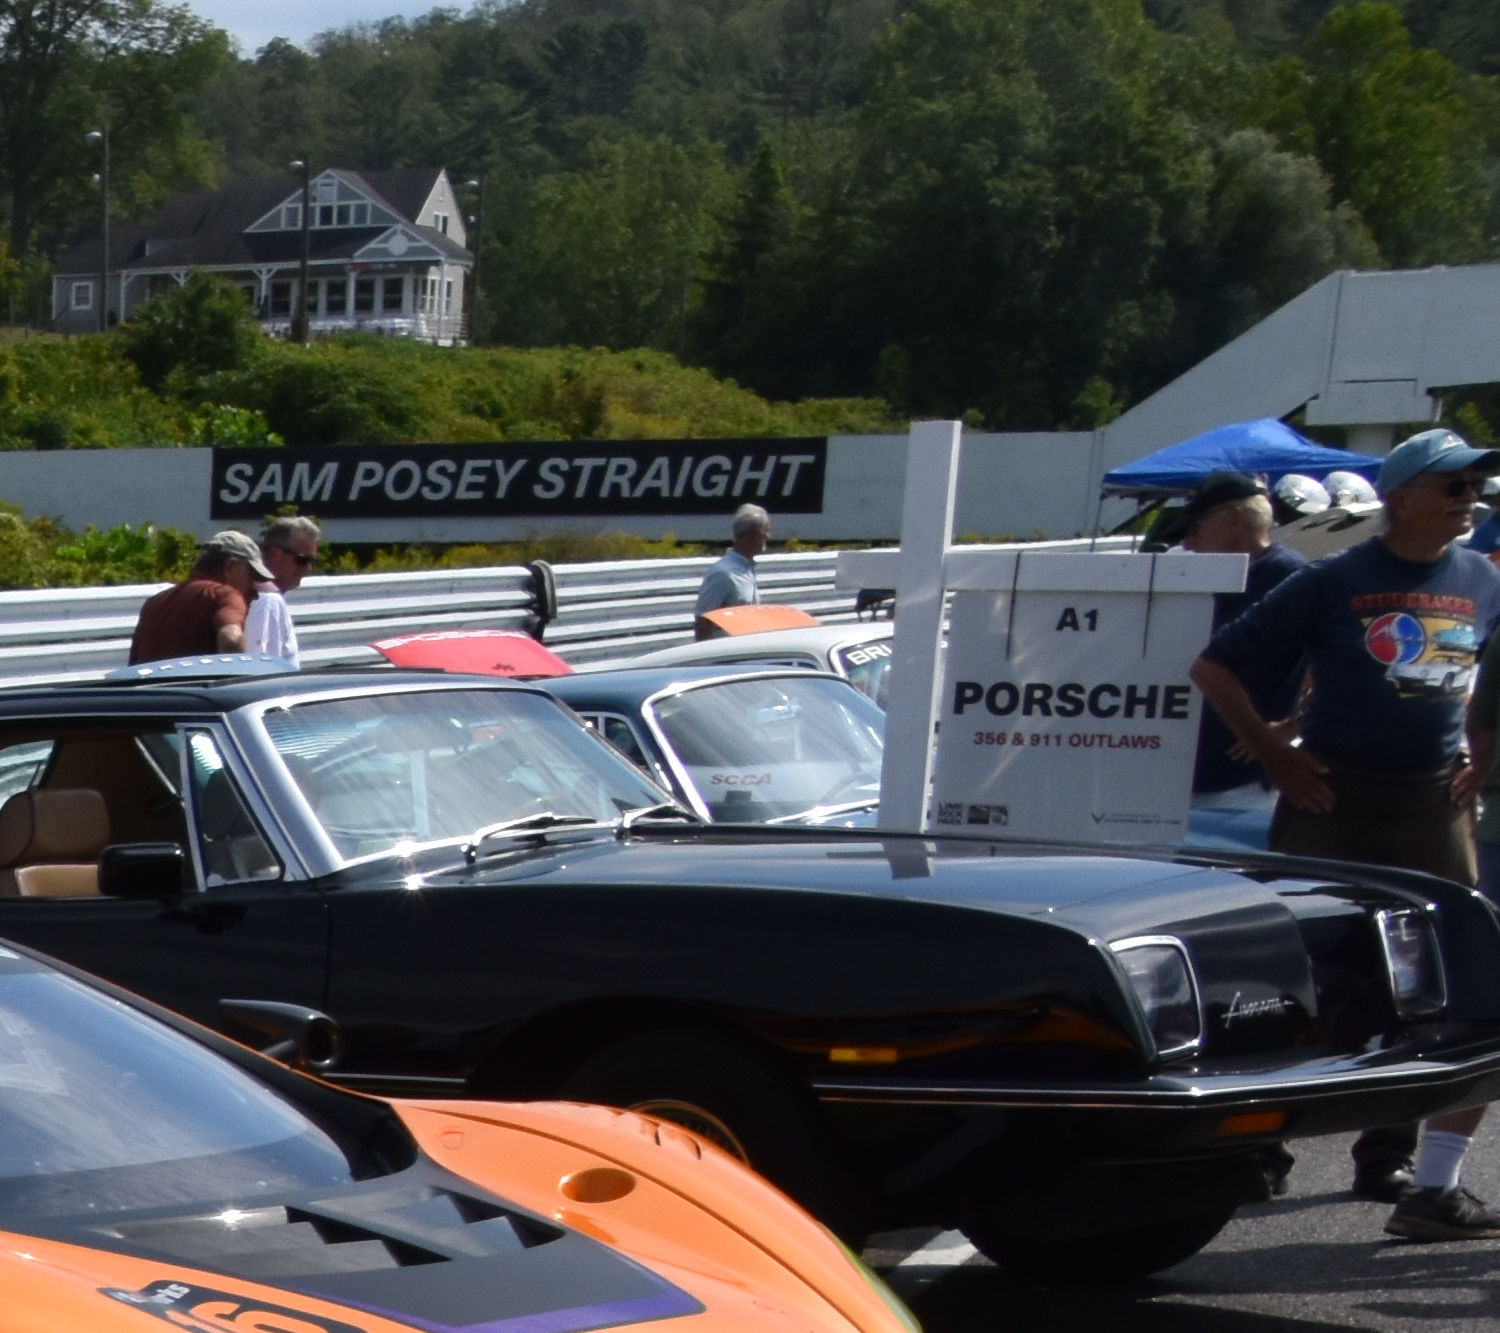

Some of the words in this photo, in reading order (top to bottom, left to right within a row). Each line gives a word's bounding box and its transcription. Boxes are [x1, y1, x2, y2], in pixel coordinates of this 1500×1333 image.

[219, 461, 338, 503] SAM
[349, 458, 529, 501] POSEY
[533, 455, 815, 499] STRAIGHT
[1055, 607, 1099, 631] A1
[953, 681, 1191, 719] PORSCHE
[973, 732, 1007, 746] 356
[1012, 733, 1025, 746] &
[1030, 733, 1062, 747] 911
[1069, 734, 1161, 749] OUTLAWS
[711, 774, 773, 785] SCCA
